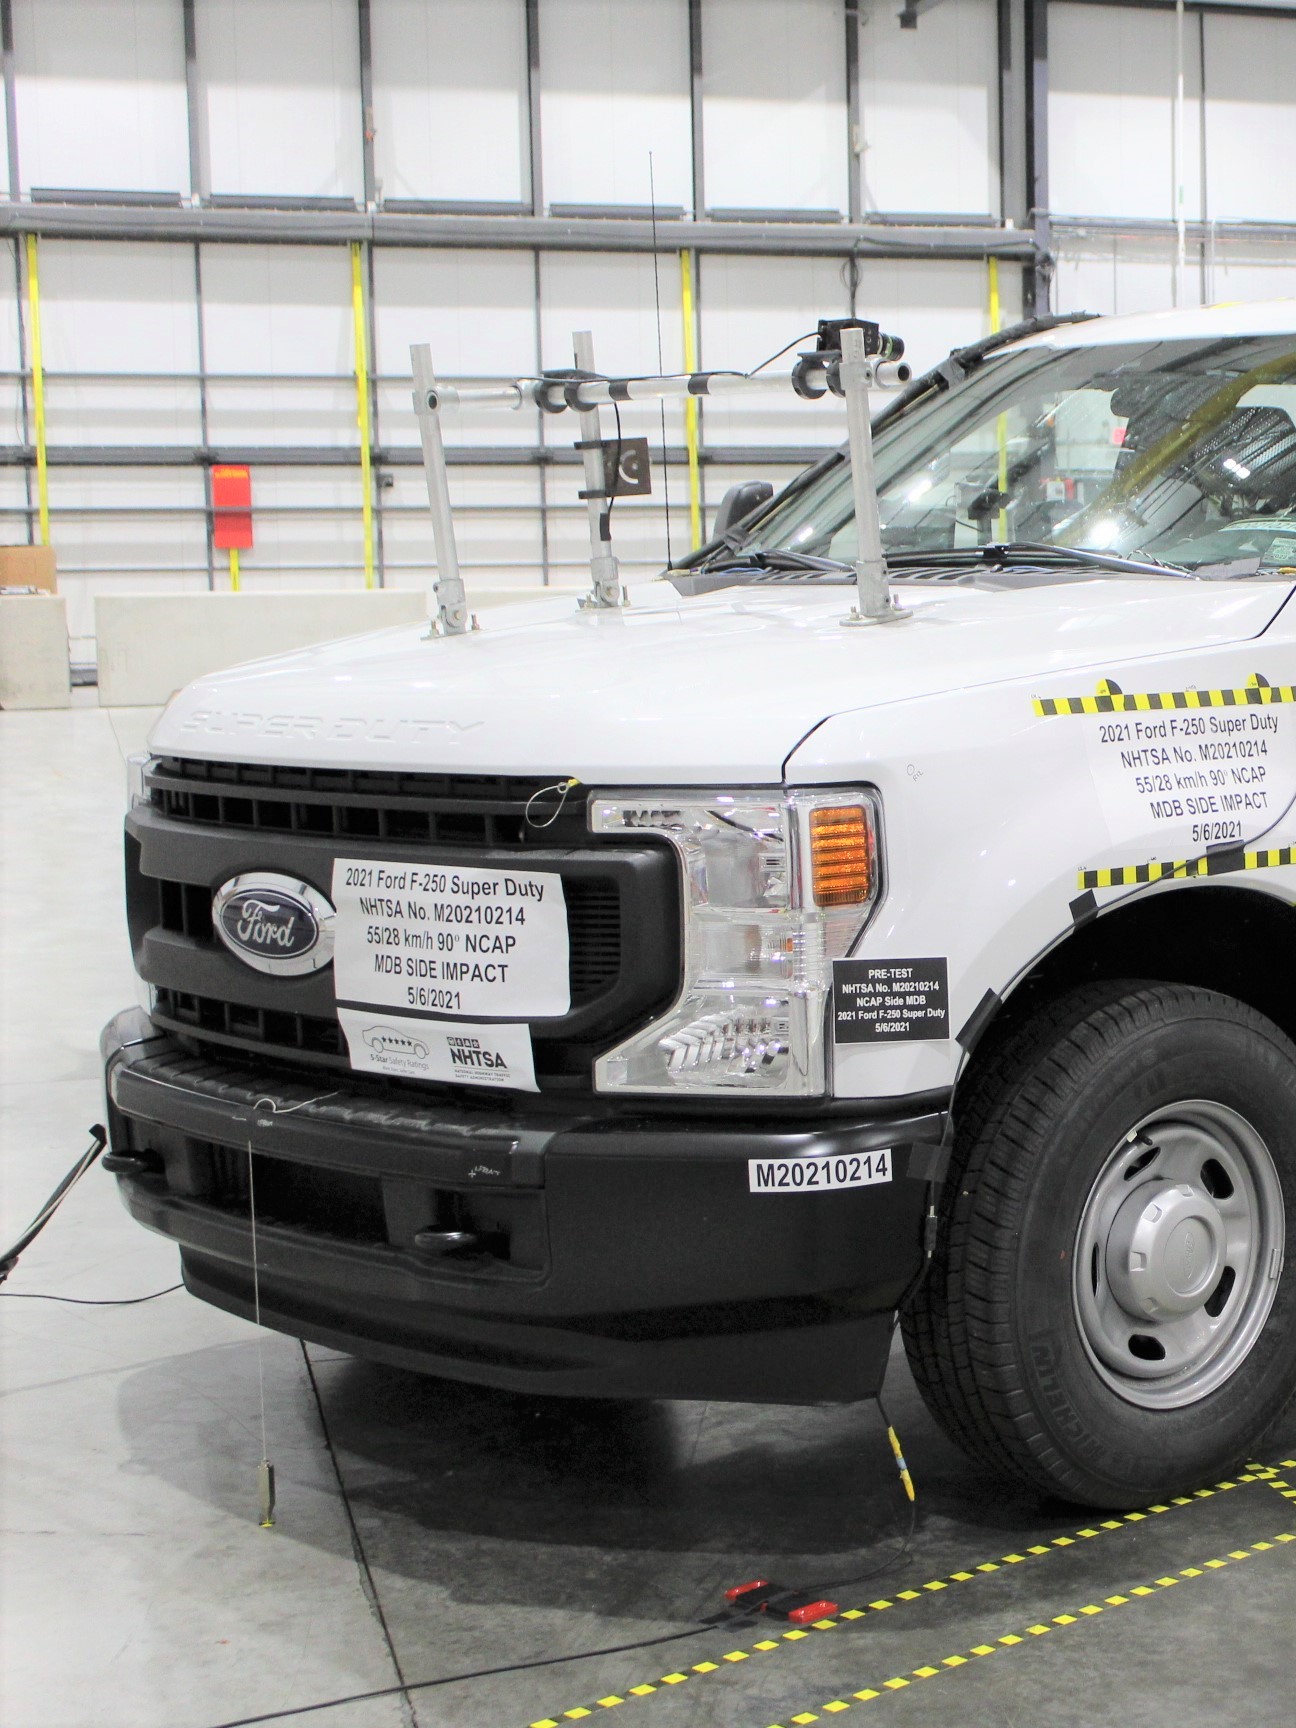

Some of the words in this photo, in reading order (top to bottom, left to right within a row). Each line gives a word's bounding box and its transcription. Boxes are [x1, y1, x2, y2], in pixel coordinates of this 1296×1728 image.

[1100, 724, 1131, 743] 2021
[1135, 721, 1167, 739] Ford
[1170, 718, 1205, 736] F-250
[1210, 716, 1247, 736] Super
[1250, 714, 1279, 734] Duty
[1121, 748, 1171, 768] NHTSA
[1174, 746, 1196, 764] No.
[1199, 740, 1267, 761] M20210214
[1136, 774, 1172, 794] 55/28
[1174, 772, 1207, 791] km/h
[1231, 766, 1266, 784] NCAP
[1150, 799, 1183, 819] MDB
[1186, 796, 1219, 815] SIDE
[1221, 792, 1268, 812] IMPACT
[1192, 820, 1242, 842] 5/6/2021
[346, 868, 373, 887] 2021
[377, 870, 406, 890] Ford
[410, 873, 446, 893] F-250
[451, 876, 499, 900] Super
[505, 878, 544, 901] Duty
[237, 899, 294, 947] Ford
[360, 897, 404, 919] NHTSA
[408, 902, 429, 921] No.
[435, 906, 525, 925] M20210214
[367, 926, 400, 945] 55/28
[404, 929, 433, 950] km/h
[466, 935, 516, 954] NCAP
[375, 954, 402, 974] MDB
[407, 957, 436, 979] SIDE
[442, 961, 509, 983] IMPACT
[868, 968, 912, 979] PRE-TEST
[408, 987, 461, 1010] 5/6/2021
[842, 984, 874, 994] NHTSA
[876, 983, 890, 992] No.
[892, 981, 939, 992] M20210214
[857, 997, 882, 1007] NCAP
[885, 996, 904, 1006] Side
[906, 995, 926, 1005] MDB
[838, 1012, 855, 1020] 2021
[858, 1010, 877, 1020] Ford
[879, 1010, 900, 1018] F-250
[902, 1009, 925, 1019] Super
[927, 1008, 945, 1019] Duty
[875, 1022, 910, 1032] 5/6/2021
[450, 1048, 508, 1068] NHTSA
[756, 1153, 888, 1187] M20210214
